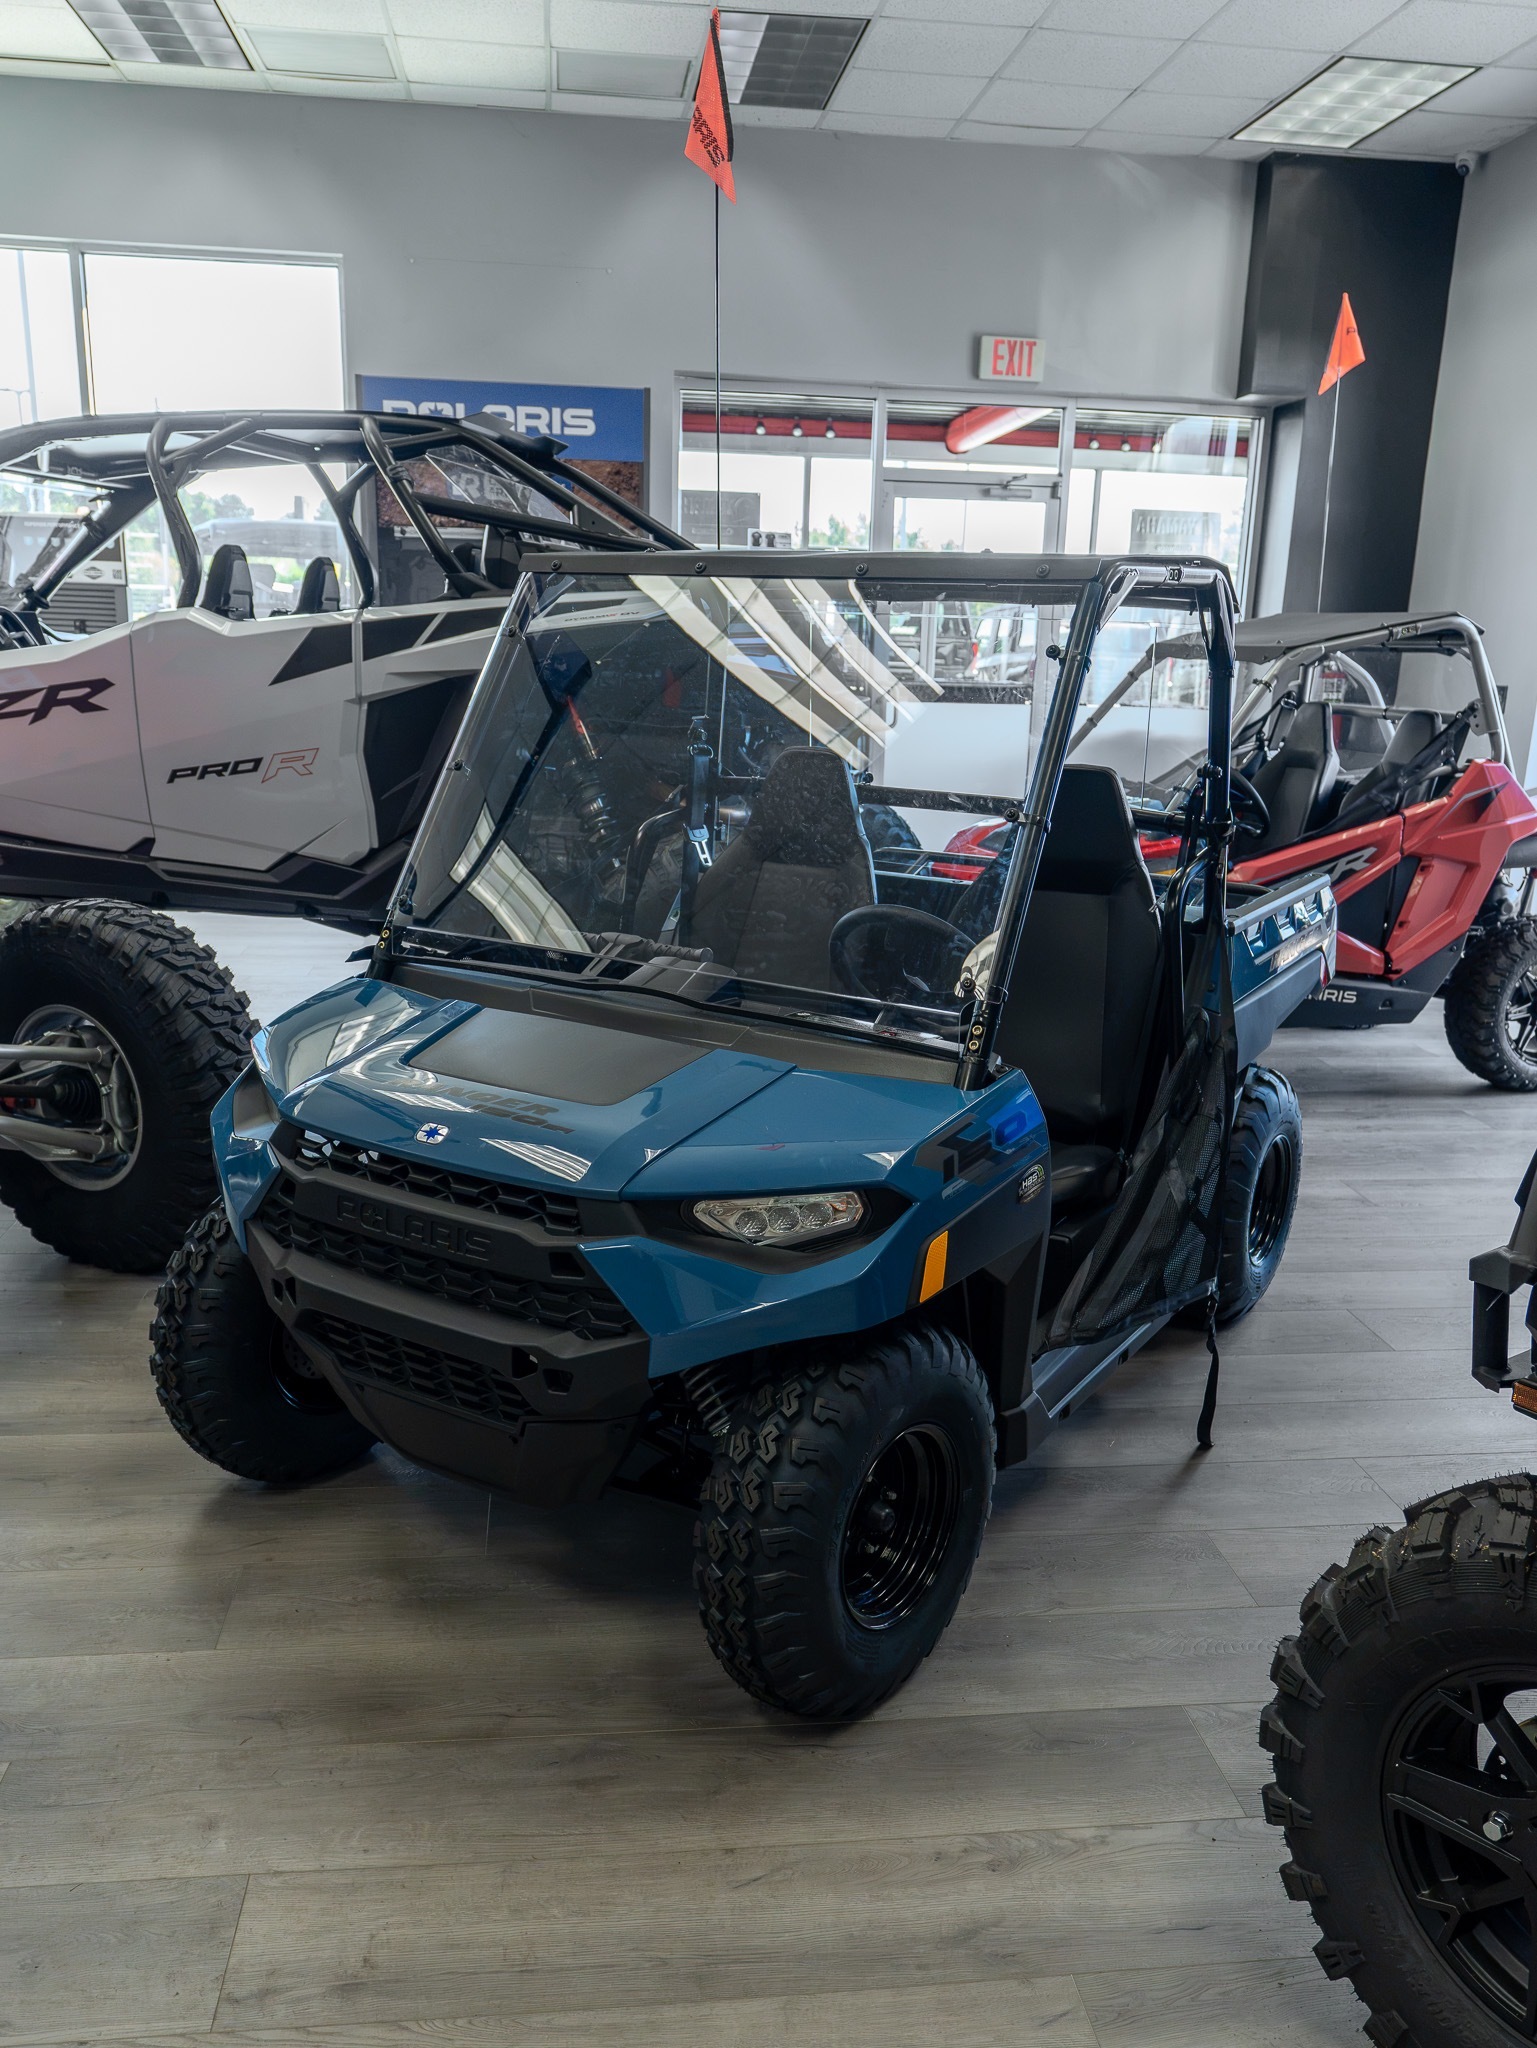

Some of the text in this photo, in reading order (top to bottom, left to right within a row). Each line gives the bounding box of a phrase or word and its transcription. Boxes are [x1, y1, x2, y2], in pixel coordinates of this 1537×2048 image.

[992, 338, 1037, 377] EXIT
[166, 747, 320, 784] PRO R
[337, 1195, 492, 1262] POLARIS
